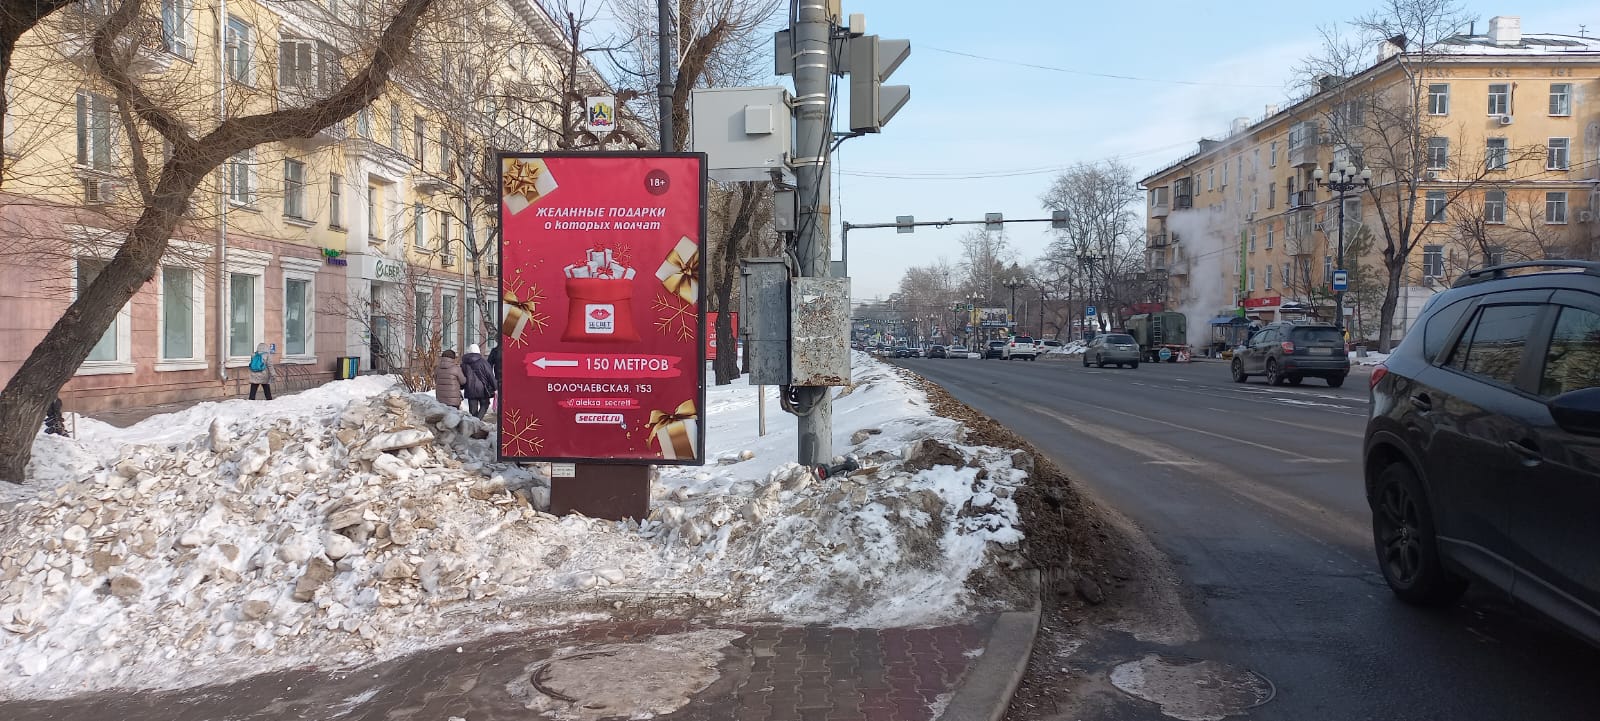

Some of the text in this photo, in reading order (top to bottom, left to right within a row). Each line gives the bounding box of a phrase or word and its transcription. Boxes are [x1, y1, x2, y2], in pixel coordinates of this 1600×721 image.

[650, 178, 666, 187] 18+
[536, 207, 666, 218] ЖЕЛАННЫЕ ПОДАРКИ
[555, 220, 610, 231] которых
[613, 221, 661, 230] молчат
[586, 358, 669, 371] 150 МЕТРОВ
[547, 383, 652, 393] ВОЛОЧАЕВСКАЯ, 153
